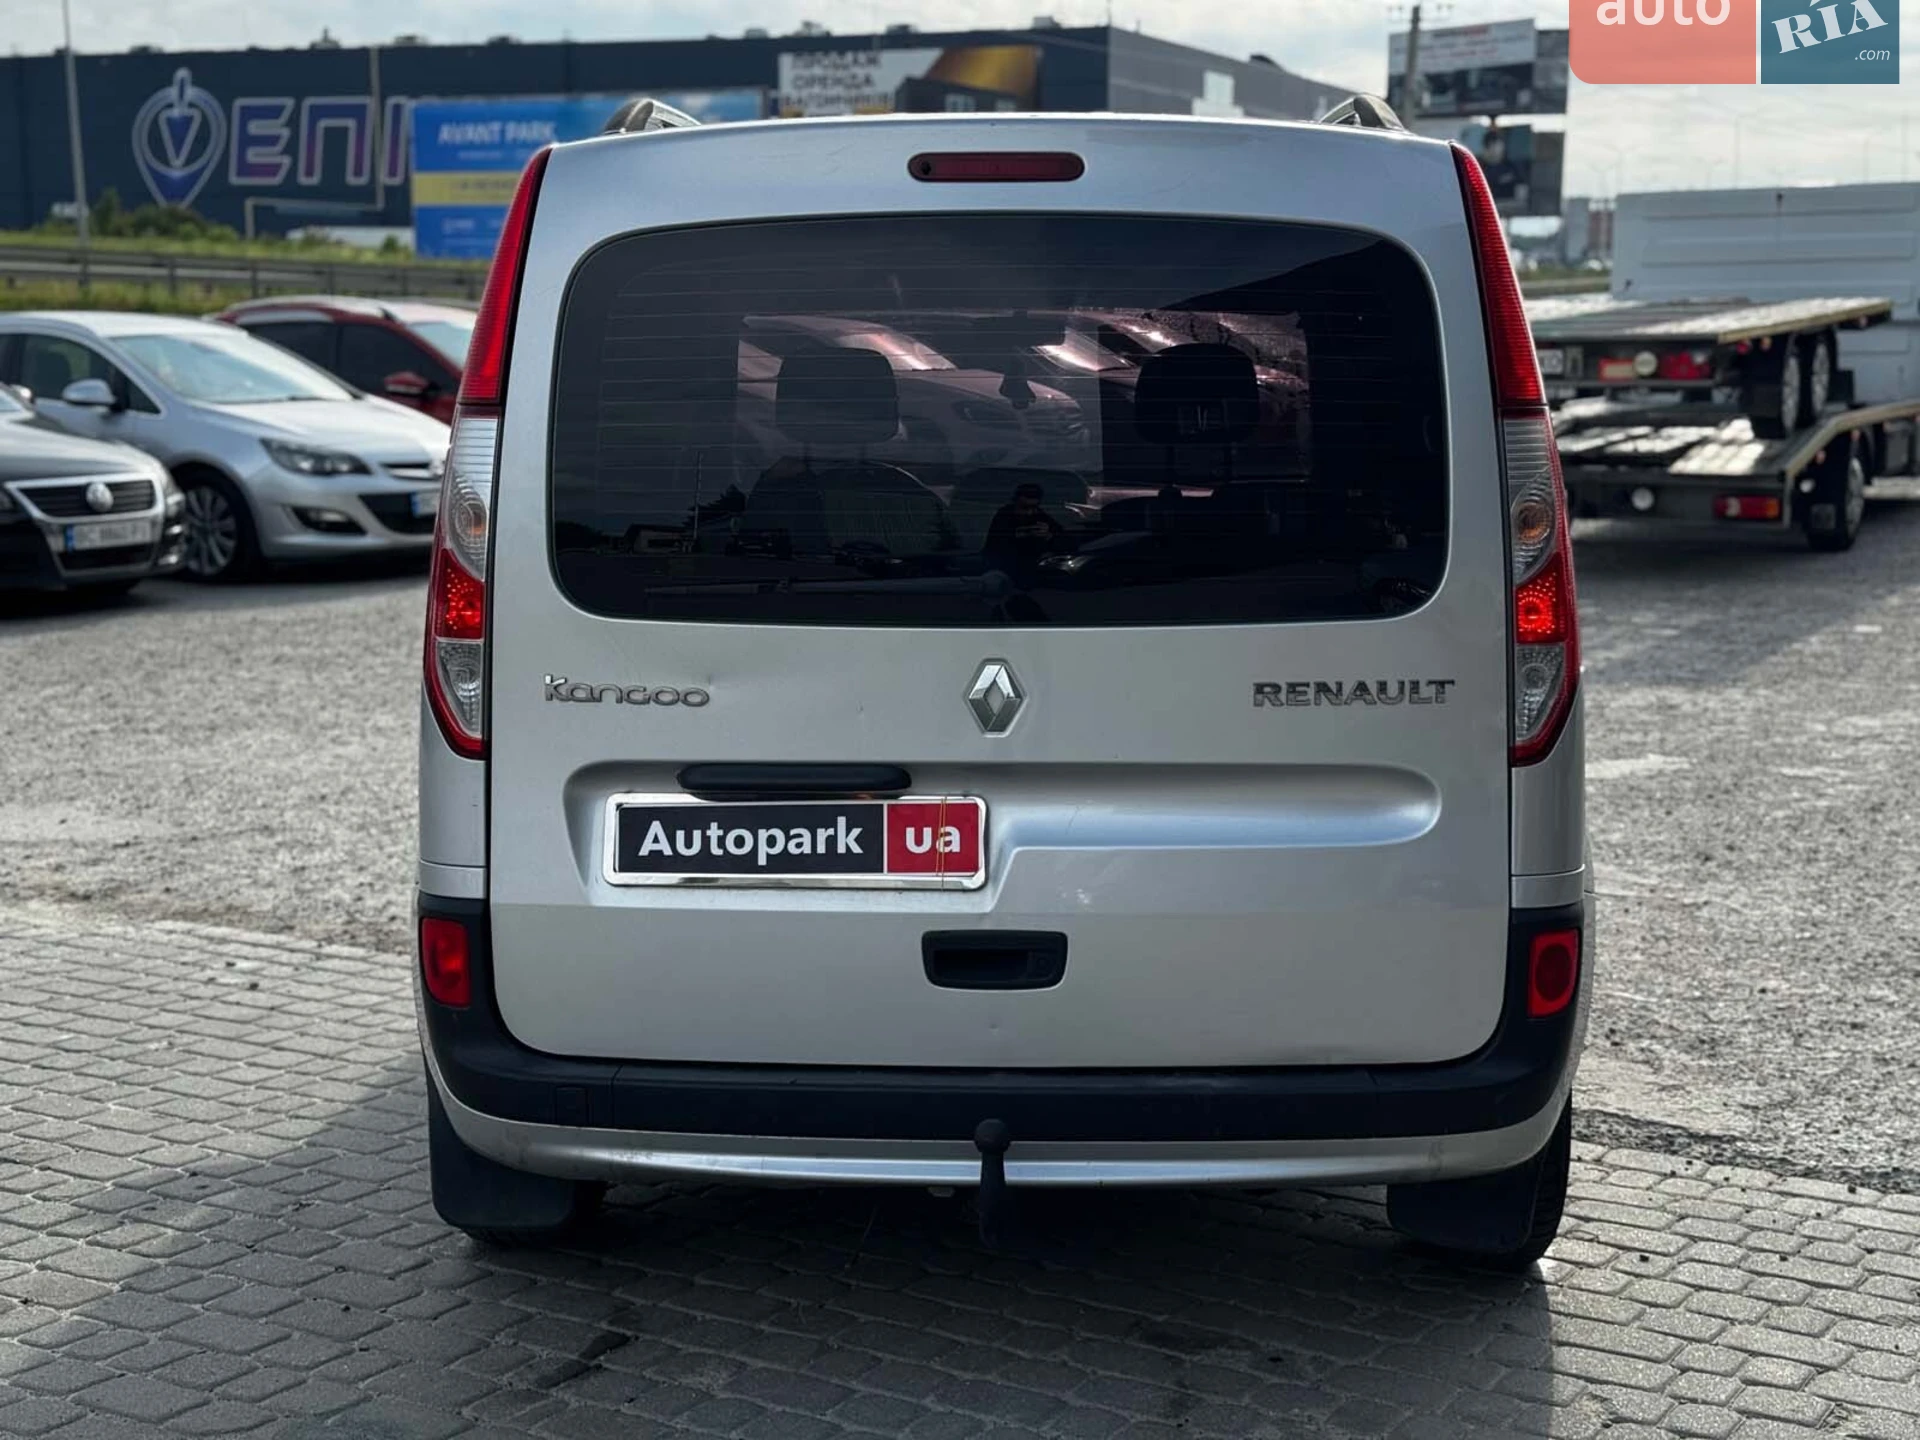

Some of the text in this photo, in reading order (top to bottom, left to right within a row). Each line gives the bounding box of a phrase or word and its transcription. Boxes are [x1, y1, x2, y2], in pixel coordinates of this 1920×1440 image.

[1253, 679, 1455, 707] RENAULT
[637, 816, 961, 866] Autopark ua
